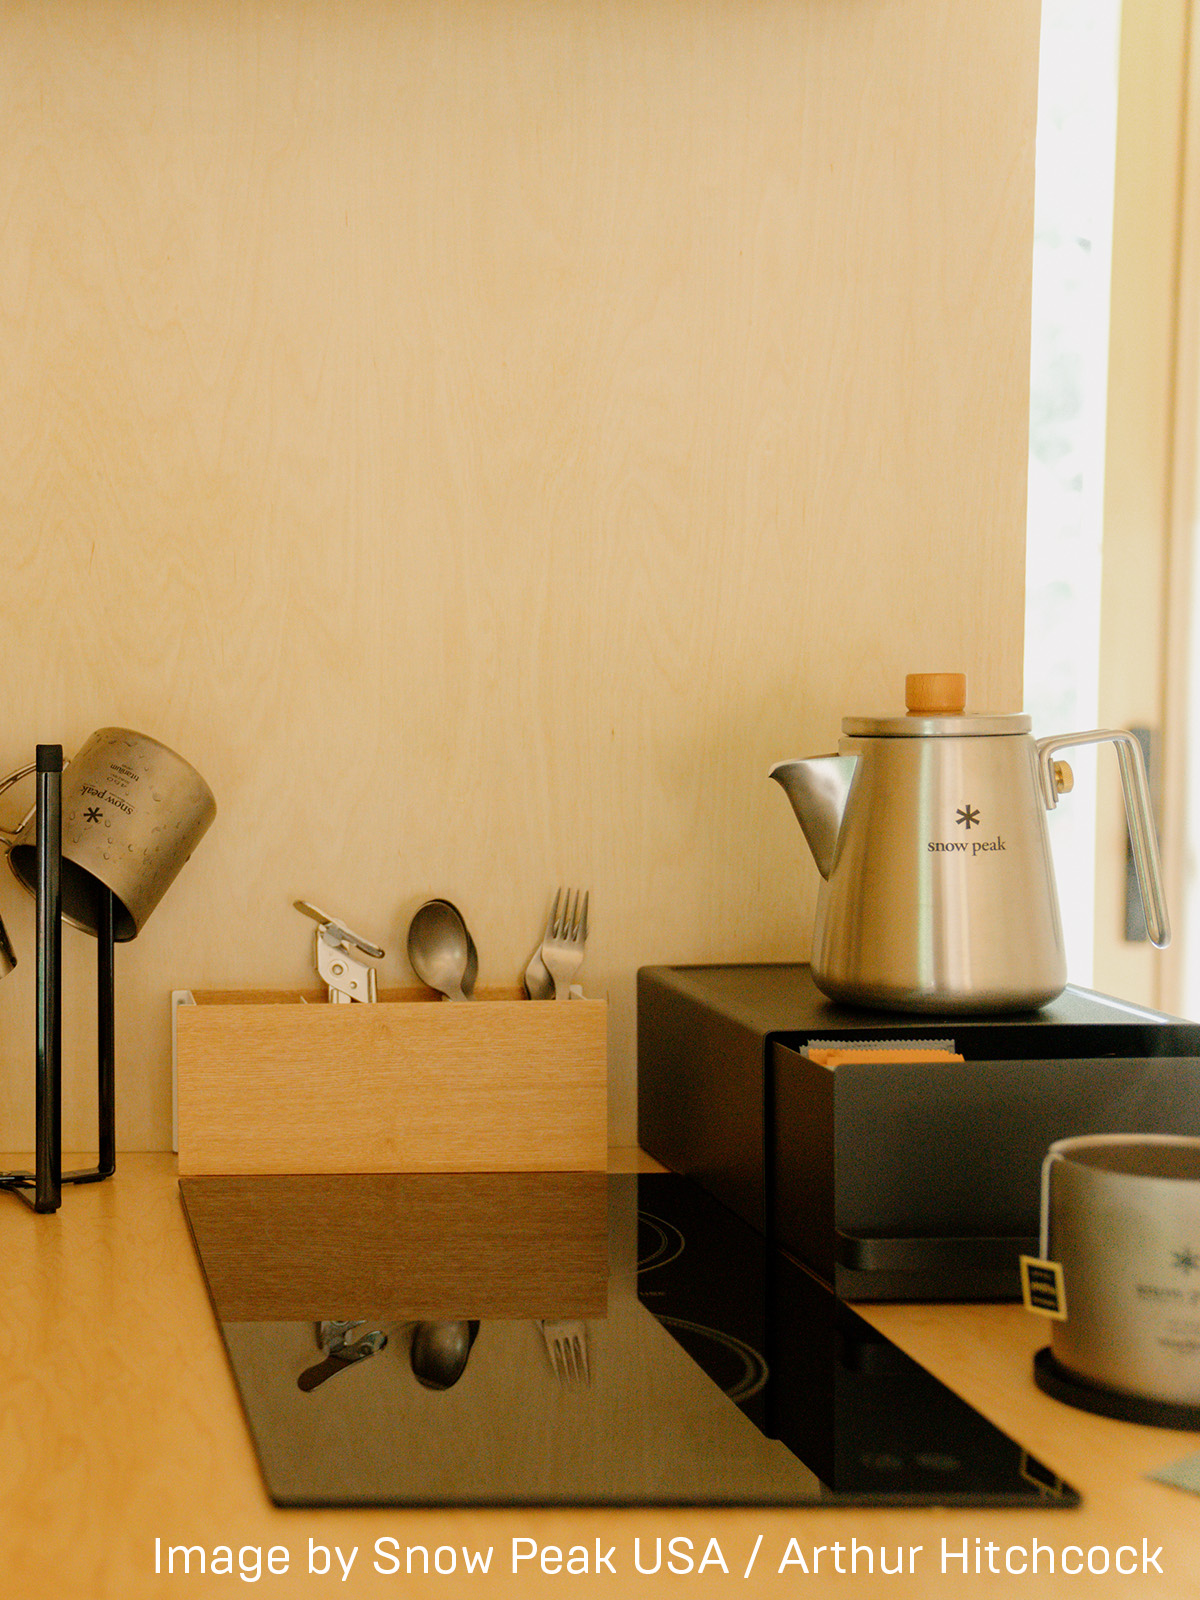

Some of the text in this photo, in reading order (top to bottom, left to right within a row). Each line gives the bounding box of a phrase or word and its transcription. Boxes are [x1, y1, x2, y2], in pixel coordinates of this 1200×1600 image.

[80, 785, 134, 815] snow peak
[927, 836, 1007, 856] snow peak
